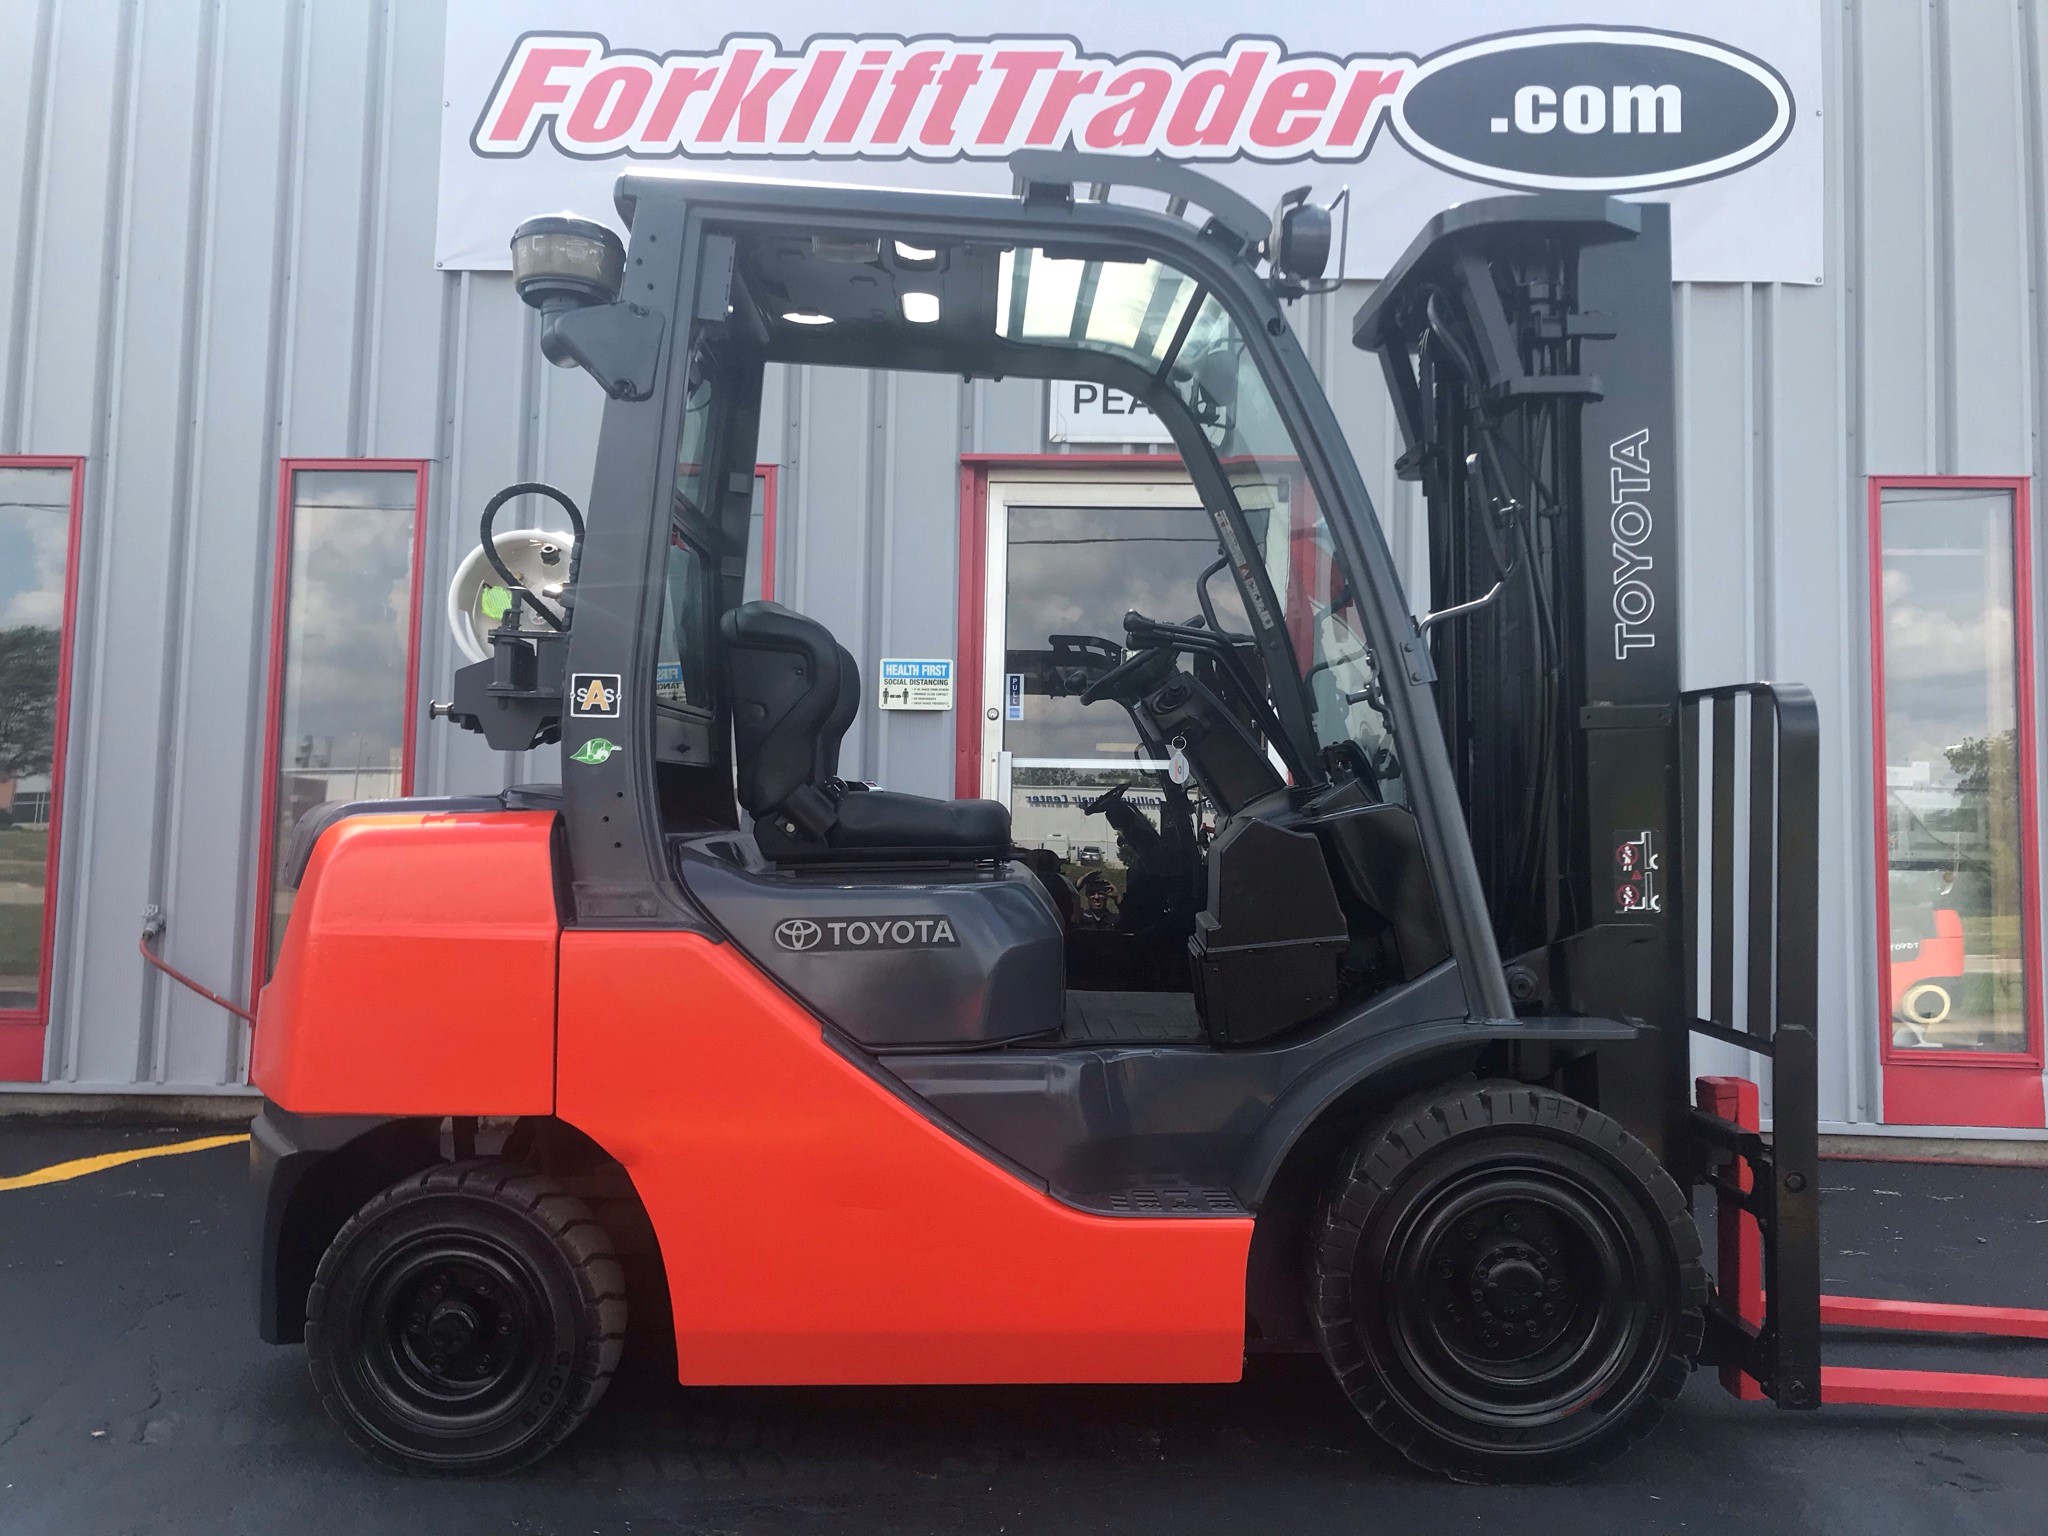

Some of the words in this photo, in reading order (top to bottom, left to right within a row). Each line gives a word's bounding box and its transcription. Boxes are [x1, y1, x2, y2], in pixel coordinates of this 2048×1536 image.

[1610, 428, 1655, 660] TOYOTA
[886, 664, 919, 676] HEALTH
[921, 664, 947, 676] FIRST
[828, 920, 955, 945] TOYOTA
